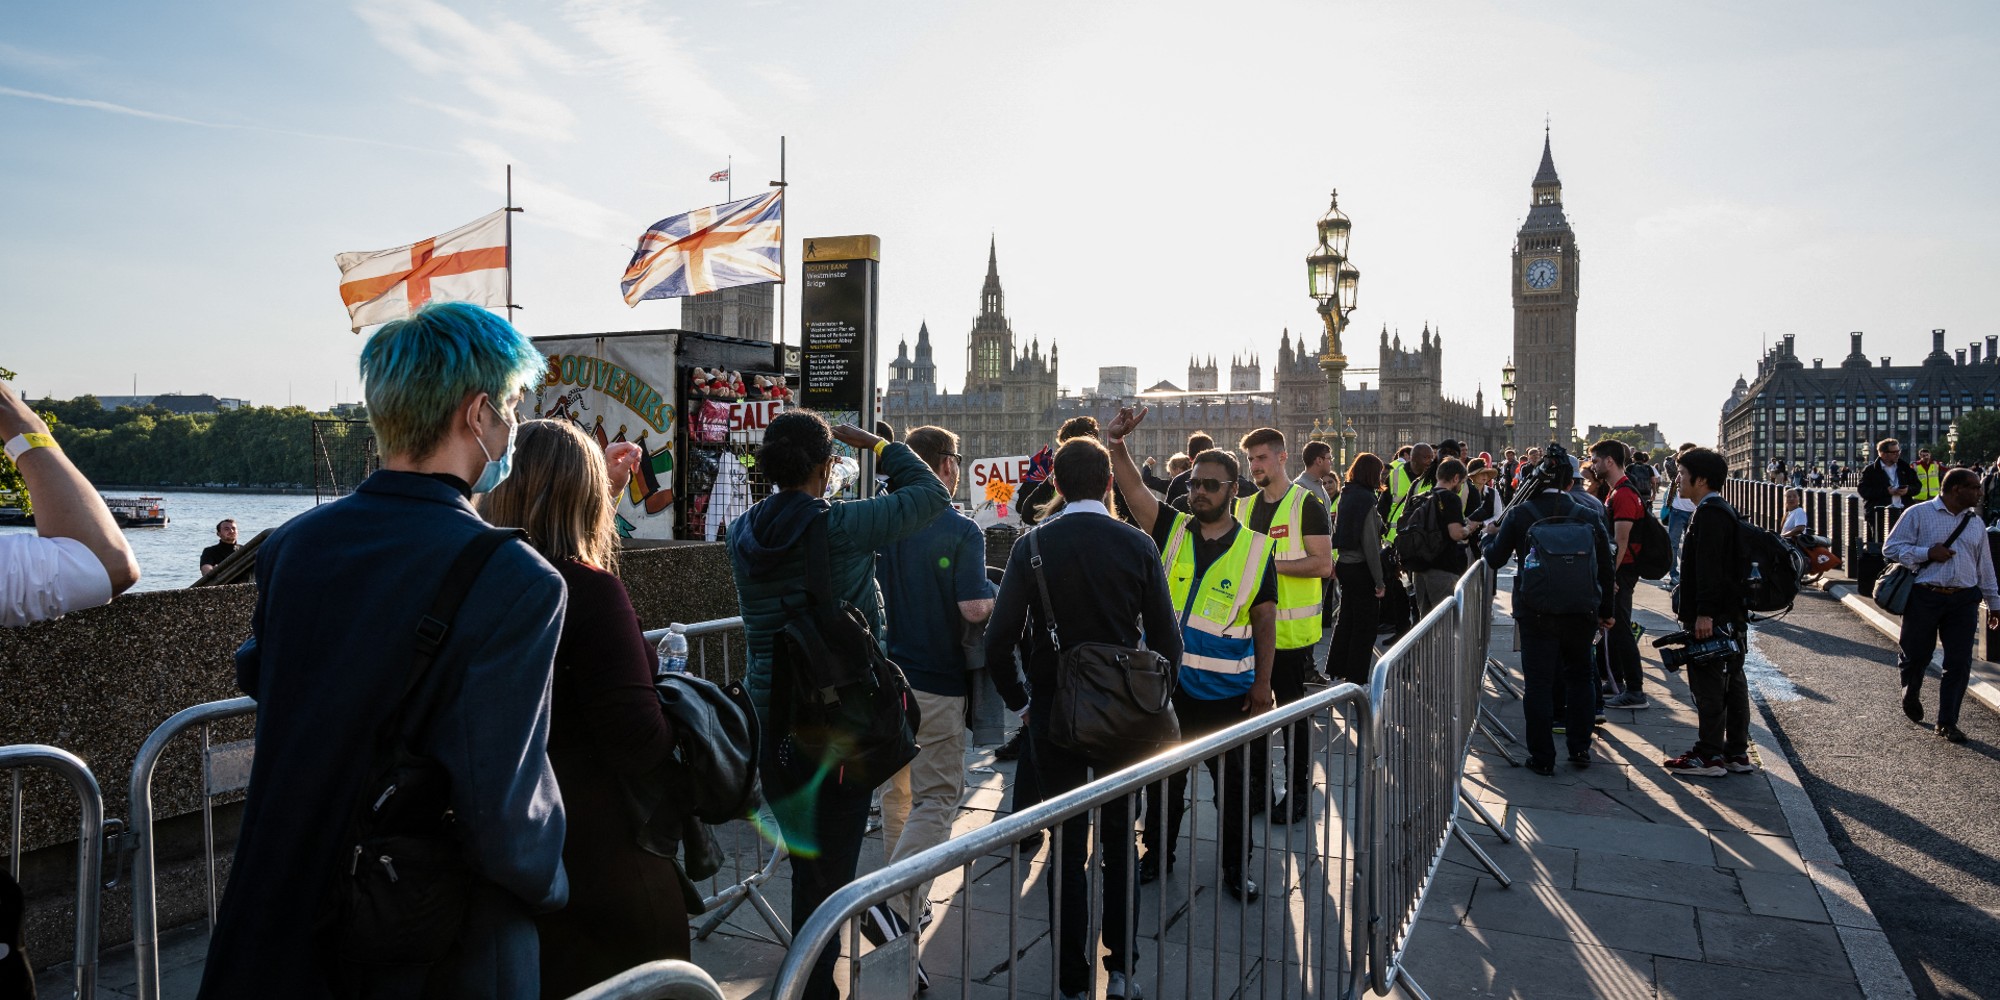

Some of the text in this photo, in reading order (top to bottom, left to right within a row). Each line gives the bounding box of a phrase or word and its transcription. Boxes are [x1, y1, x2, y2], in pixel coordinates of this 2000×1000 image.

[806, 264, 829, 272] SOUTH
[806, 271, 847, 279] Westminster
[806, 280, 826, 288] Bridge
[545, 354, 677, 434] SOUVENIRS
[974, 460, 1030, 487] SALE
